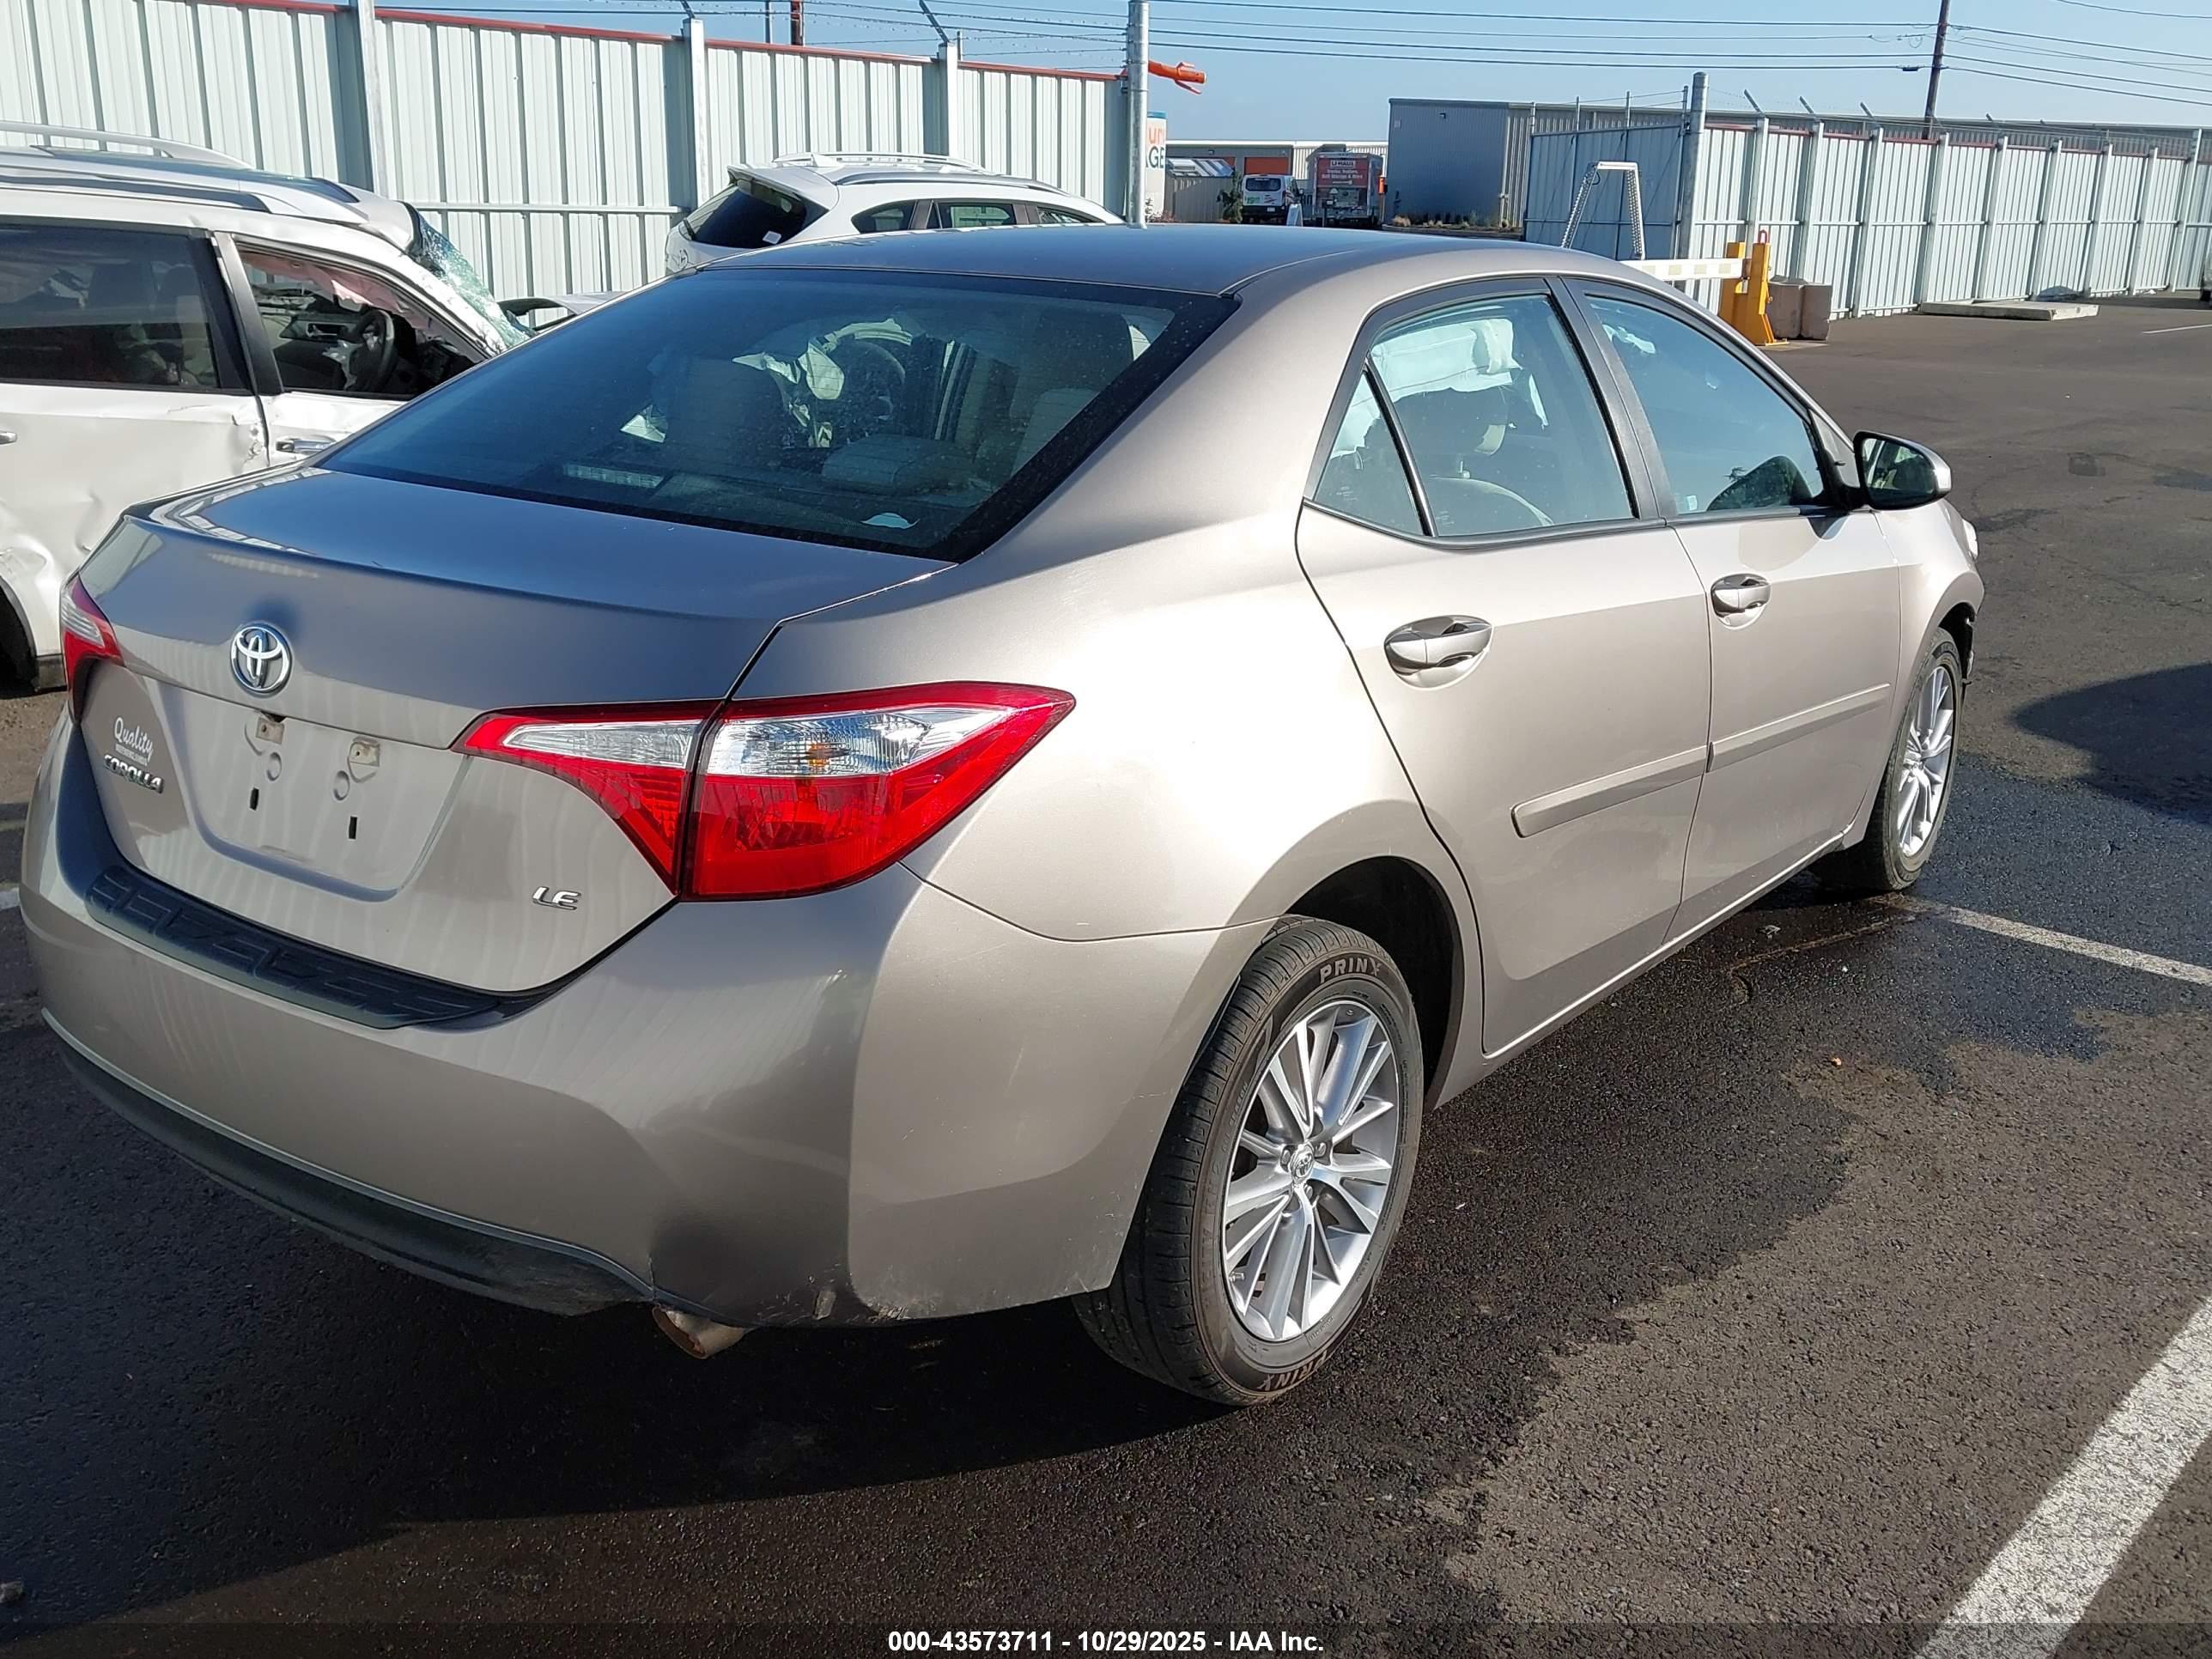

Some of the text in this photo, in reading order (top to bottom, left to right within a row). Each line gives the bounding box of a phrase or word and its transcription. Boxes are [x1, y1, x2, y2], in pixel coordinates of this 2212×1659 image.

[1146, 145, 1164, 169] GE
[113, 716, 154, 763] Quality
[104, 754, 165, 794] COROLLA
[532, 885, 582, 911] LE
